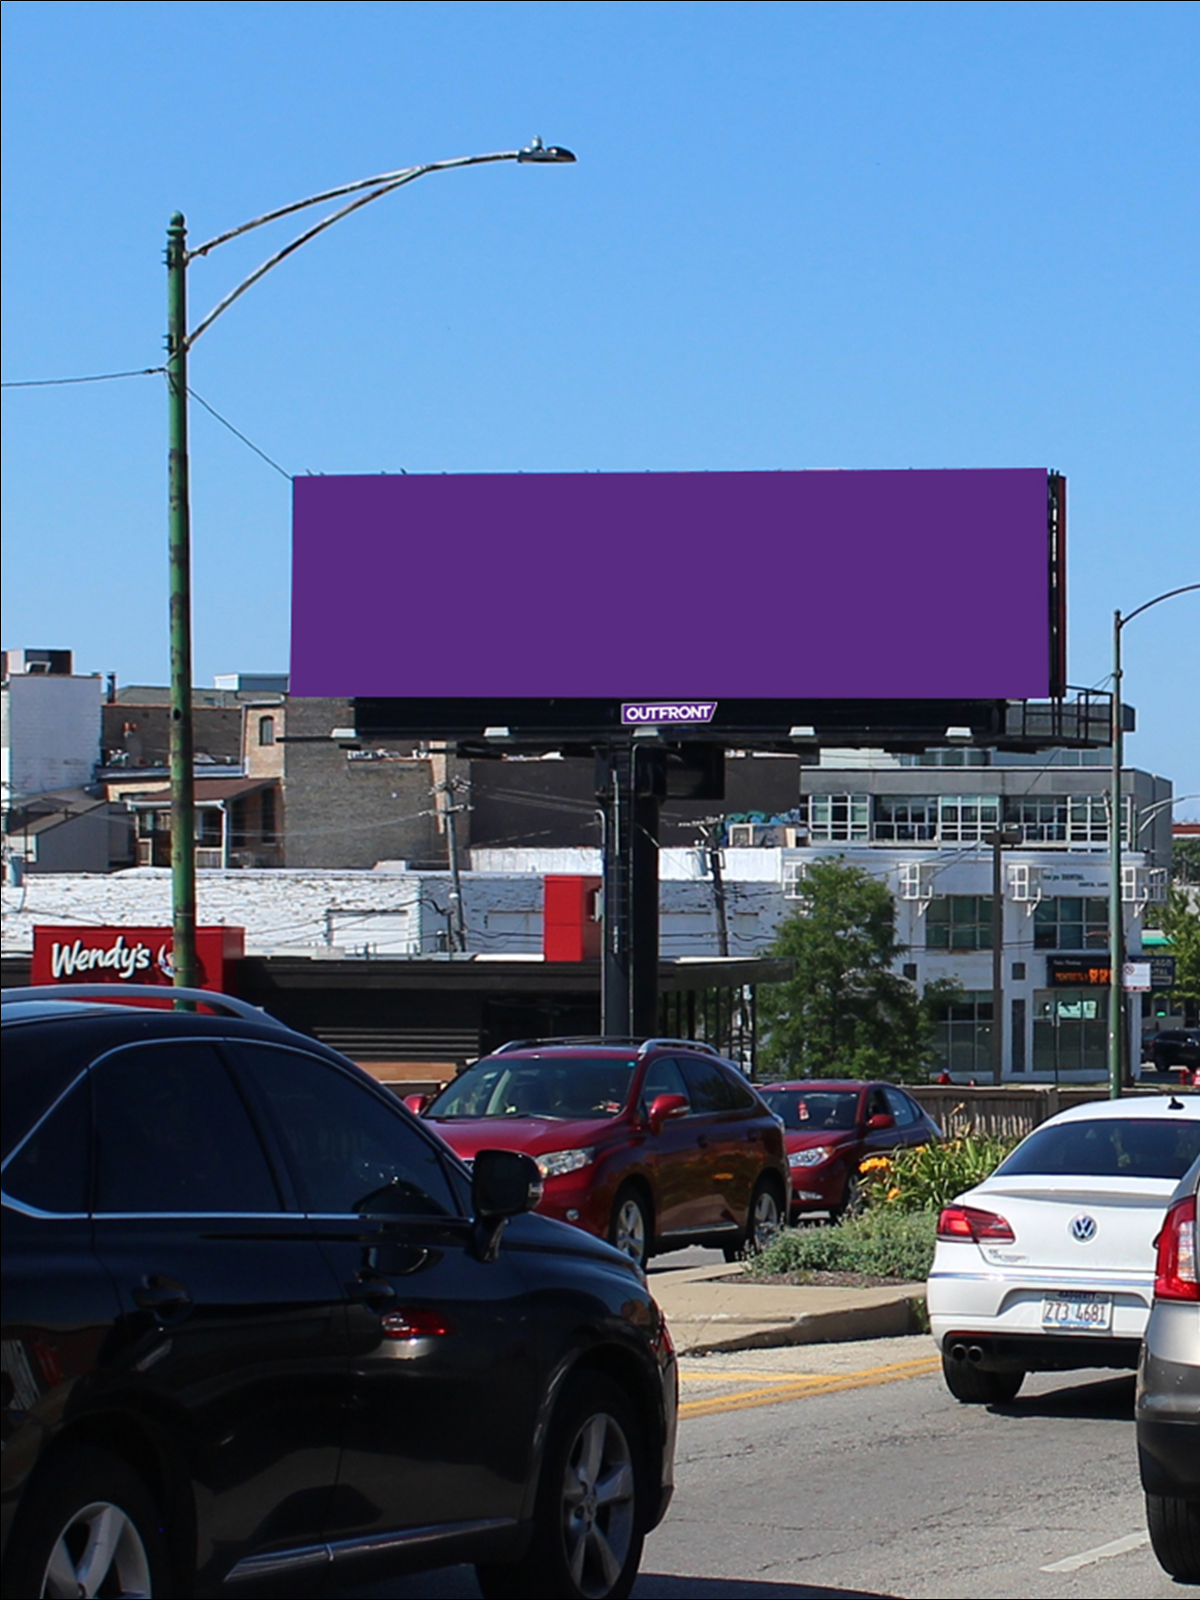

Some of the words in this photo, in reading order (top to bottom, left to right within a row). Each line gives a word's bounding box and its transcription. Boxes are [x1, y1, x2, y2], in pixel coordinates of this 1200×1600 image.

[626, 706, 712, 720] OUTFRONT
[52, 935, 151, 978] Wendy's
[1076, 1303, 1106, 1322] 4681
